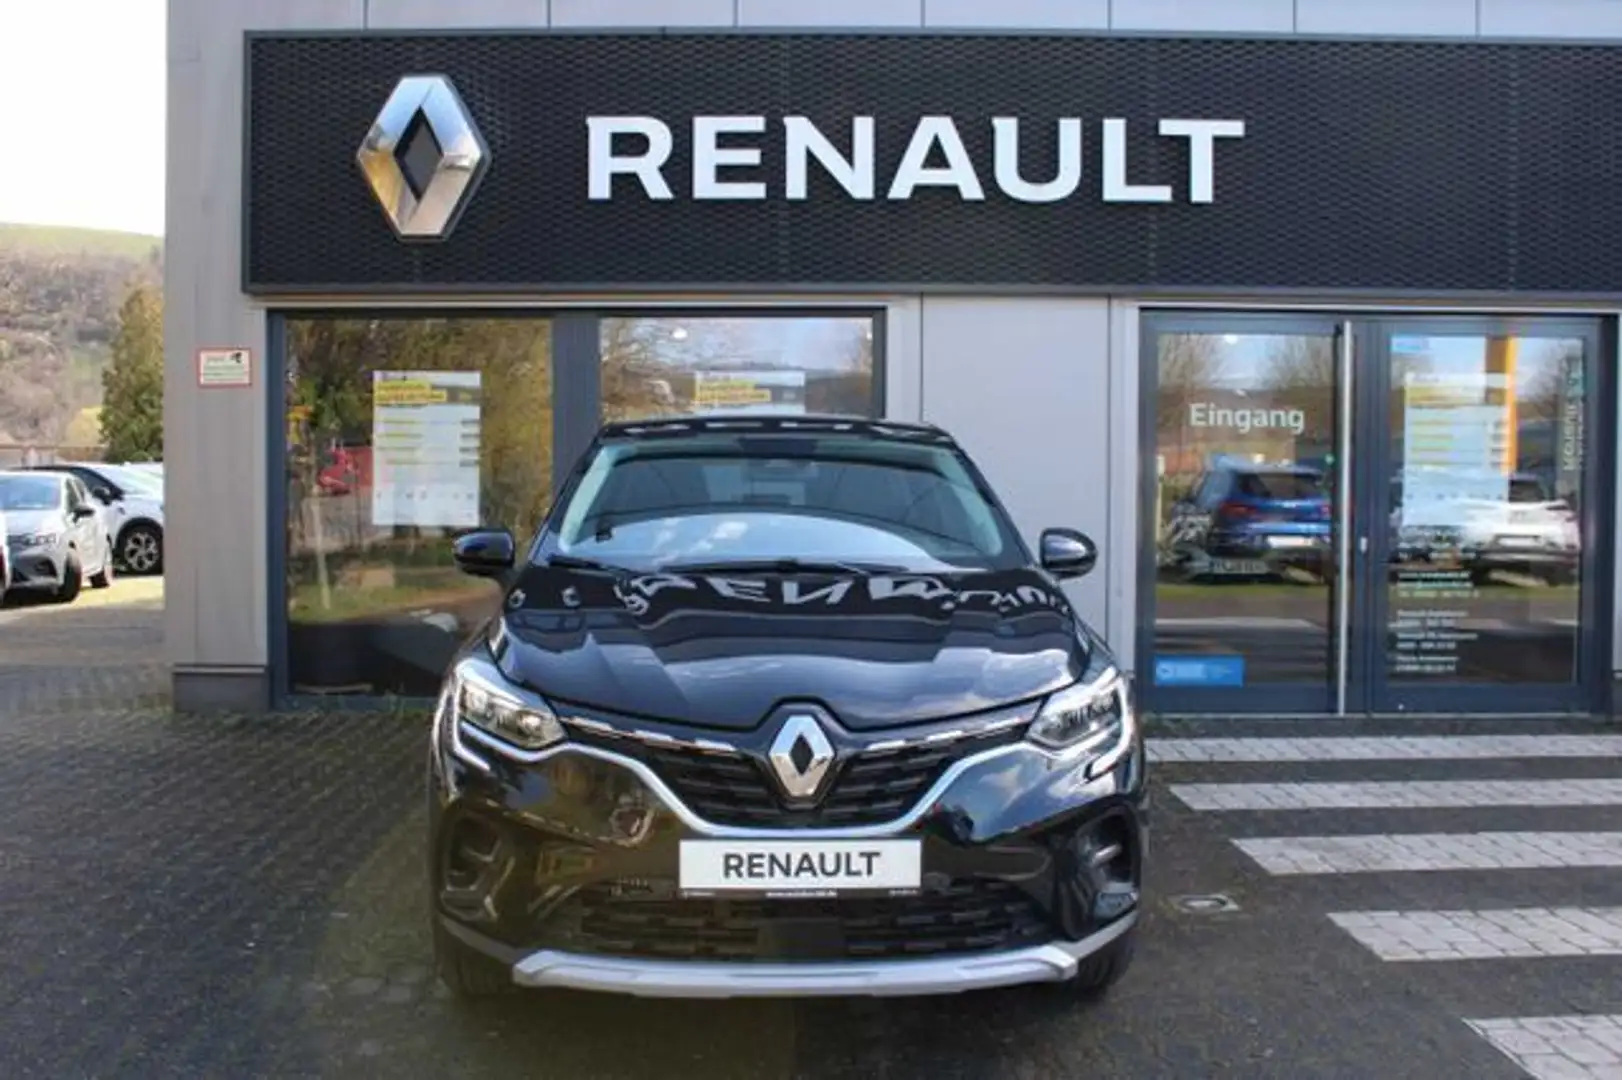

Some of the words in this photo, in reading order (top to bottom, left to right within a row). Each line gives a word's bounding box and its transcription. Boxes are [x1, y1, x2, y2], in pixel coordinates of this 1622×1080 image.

[586, 115, 1244, 203] RENAULT
[1189, 402, 1305, 435] Eingang
[723, 851, 881, 879] RENAULT
